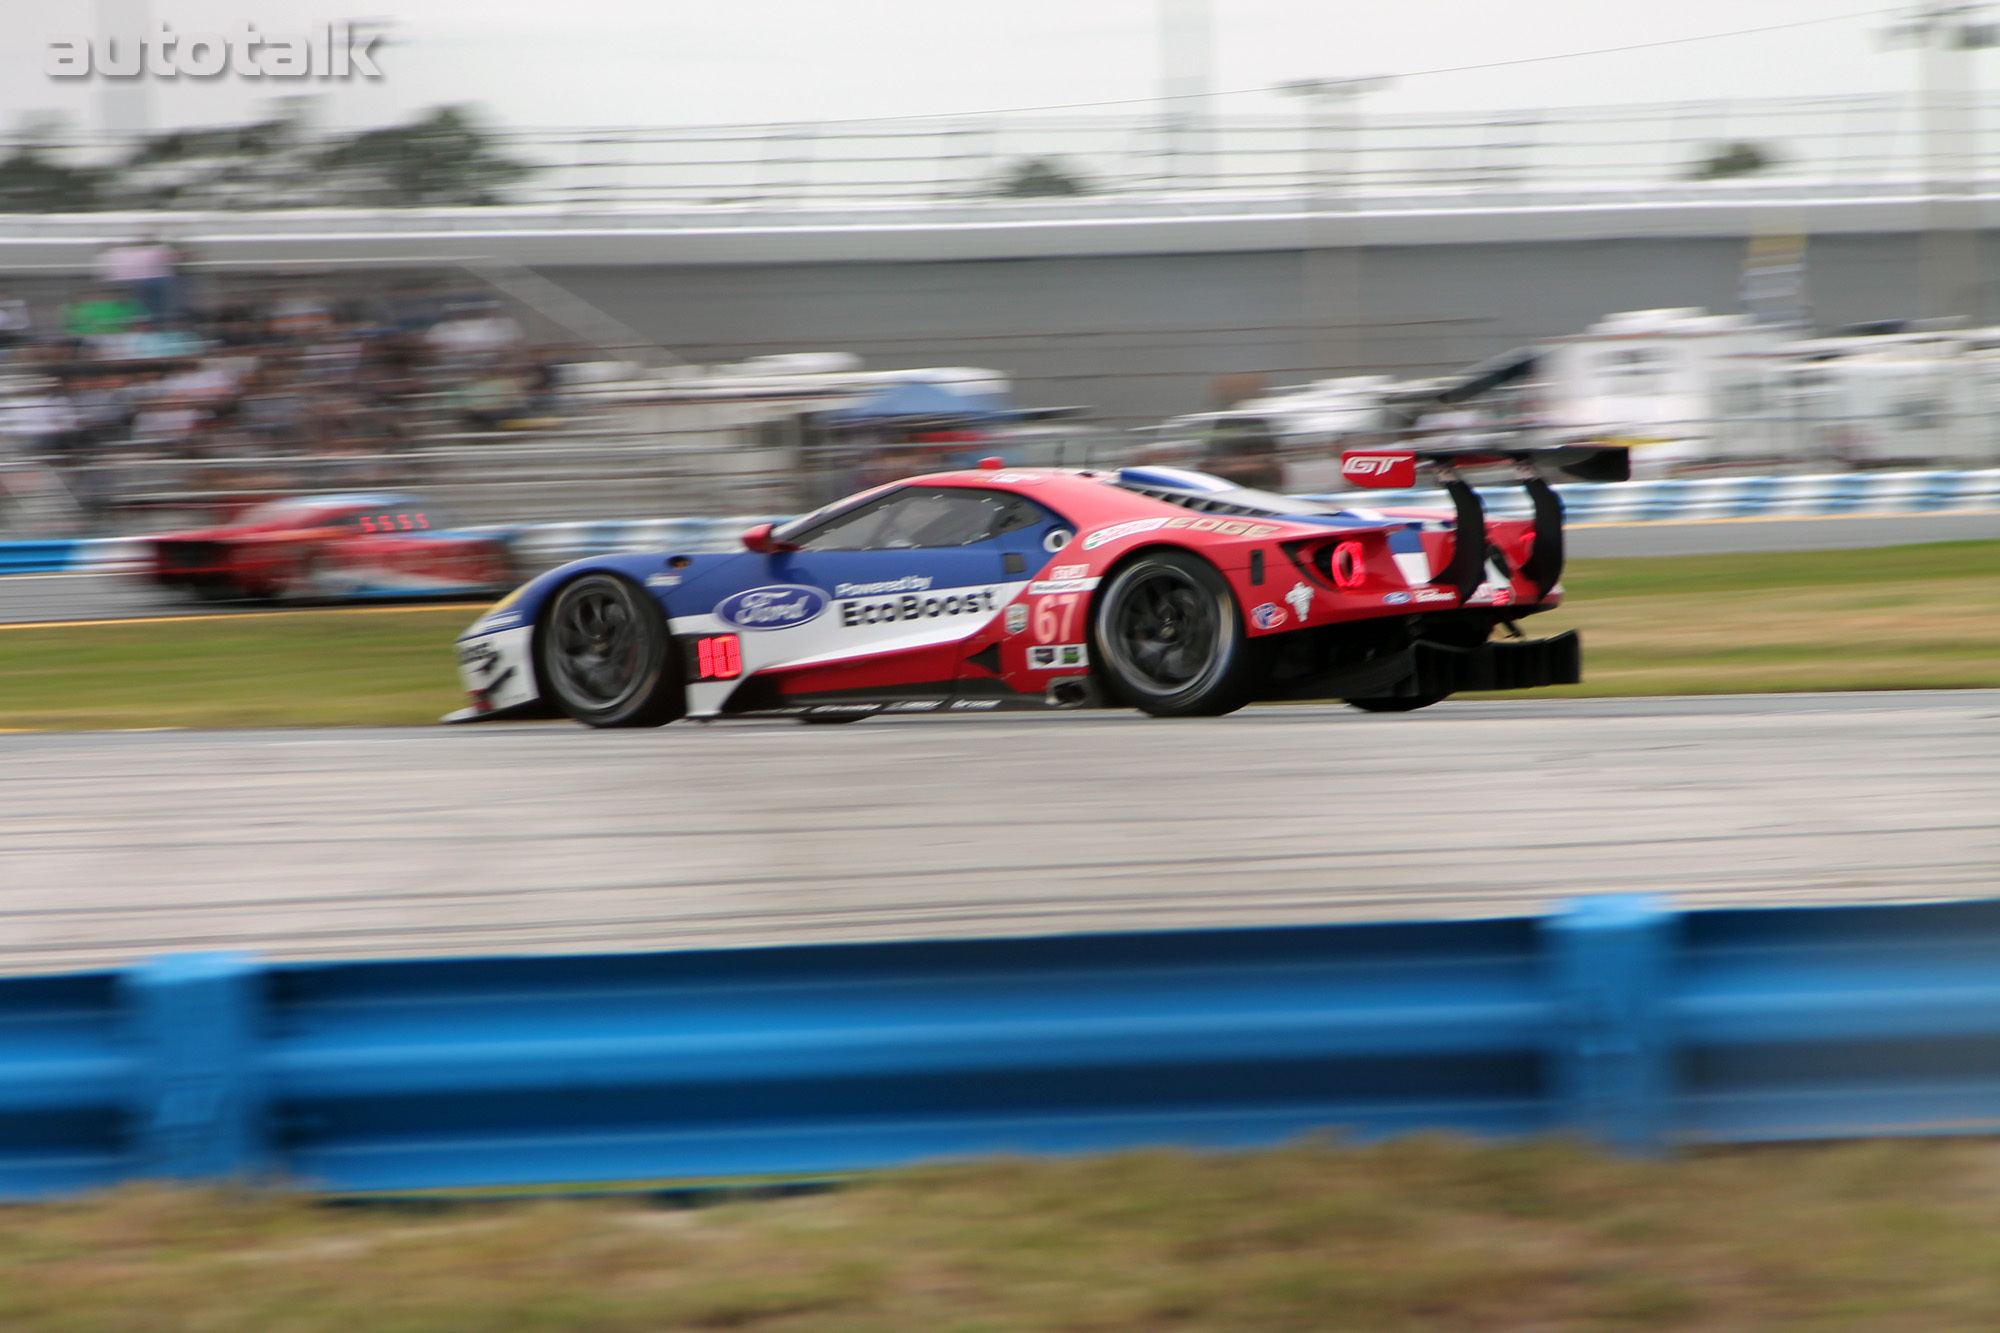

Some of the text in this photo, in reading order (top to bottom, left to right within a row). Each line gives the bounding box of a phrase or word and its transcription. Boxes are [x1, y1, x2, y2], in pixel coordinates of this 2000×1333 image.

[1341, 456, 1413, 476] GT
[1162, 516, 1282, 538] EDGE
[834, 578, 909, 598] Powered
[734, 590, 810, 625] Ford
[842, 587, 998, 628] EcoBoost
[1034, 593, 1079, 645] 67
